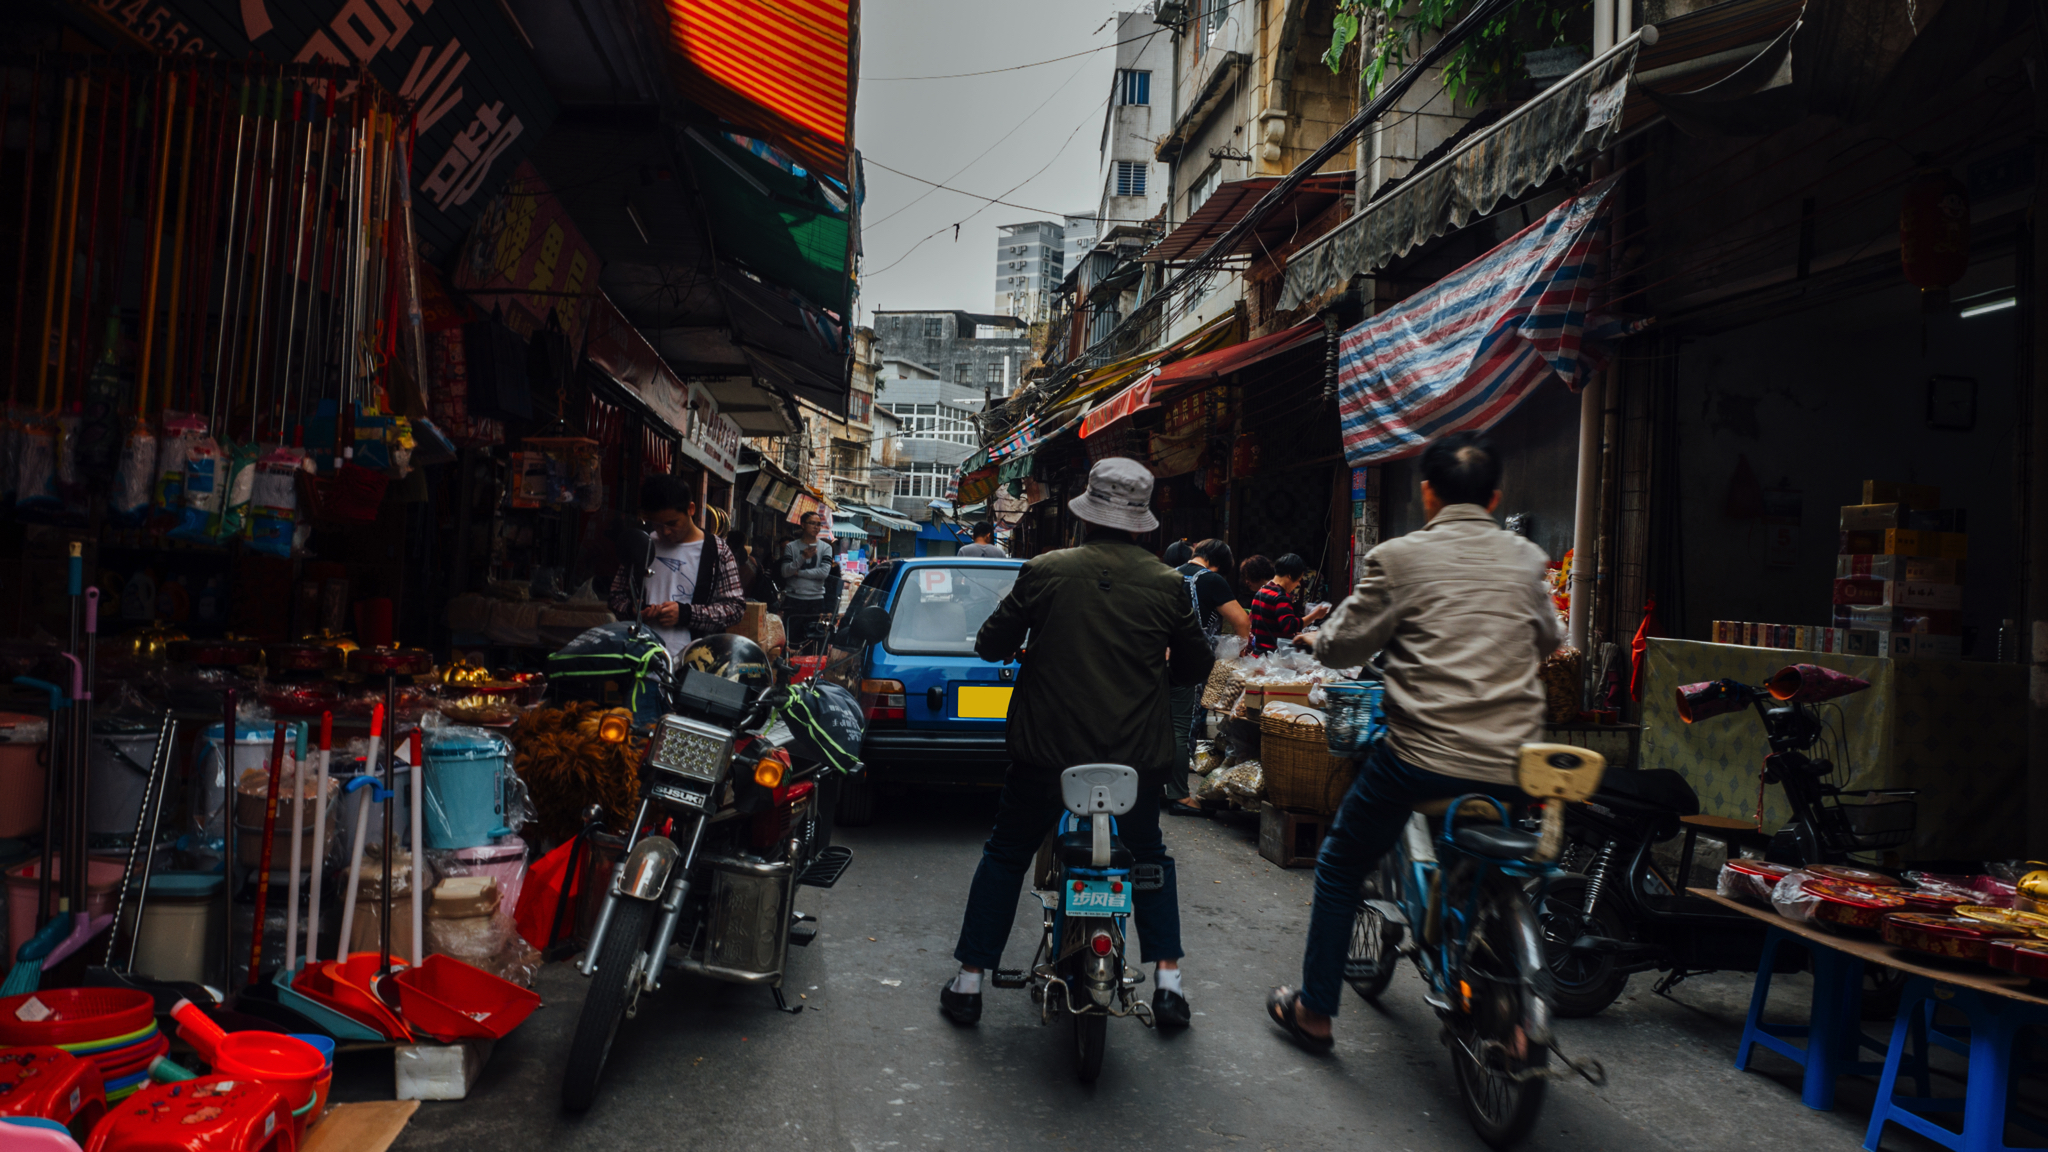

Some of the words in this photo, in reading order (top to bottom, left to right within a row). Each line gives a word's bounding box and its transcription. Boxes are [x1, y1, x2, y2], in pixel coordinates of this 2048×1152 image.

[239, 0, 524, 212] 营业部
[1777, 528, 1791, 546] 5
[925, 571, 946, 592] P
